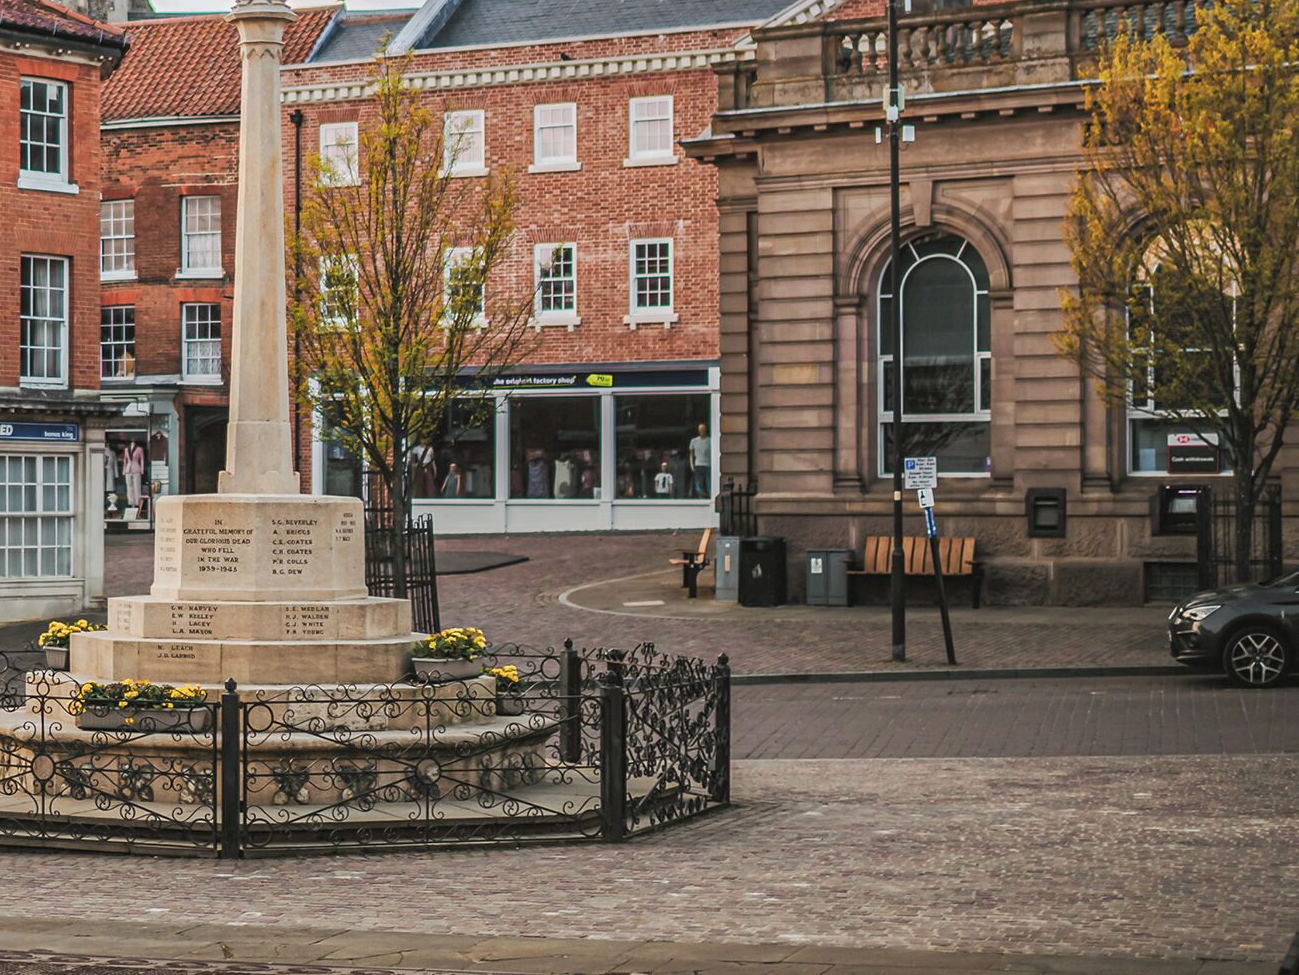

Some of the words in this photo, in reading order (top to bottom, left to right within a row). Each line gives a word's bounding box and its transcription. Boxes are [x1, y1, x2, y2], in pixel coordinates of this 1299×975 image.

[533, 376, 556, 385] factory
[558, 376, 575, 385] shop
[61, 431, 73, 439] king
